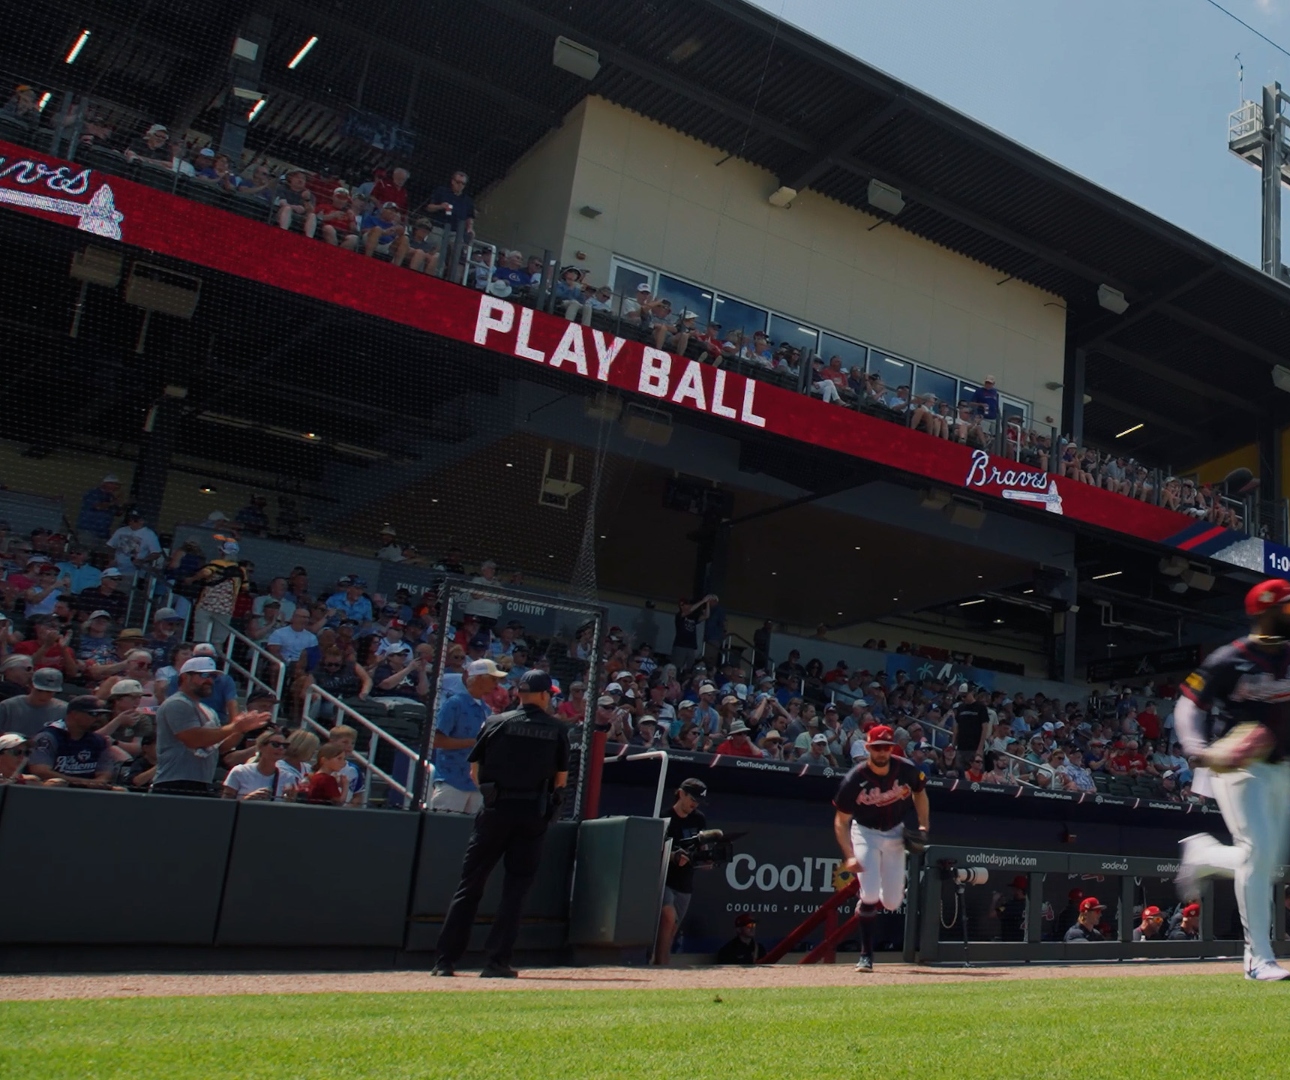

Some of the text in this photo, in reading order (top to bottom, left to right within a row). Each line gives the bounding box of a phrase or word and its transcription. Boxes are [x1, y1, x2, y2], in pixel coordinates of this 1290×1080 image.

[474, 294, 766, 428] PLAY BALL
[966, 449, 1047, 489] Braves
[396, 582, 418, 594] THIS
[507, 601, 546, 616] COUNTRY
[507, 725, 555, 739] POLICE
[736, 760, 790, 772] CoolTodayPark.com
[966, 853, 1037, 867] cooltodaypark.com
[1101, 858, 1129, 871] sodexo
[726, 902, 778, 913] COOLING
